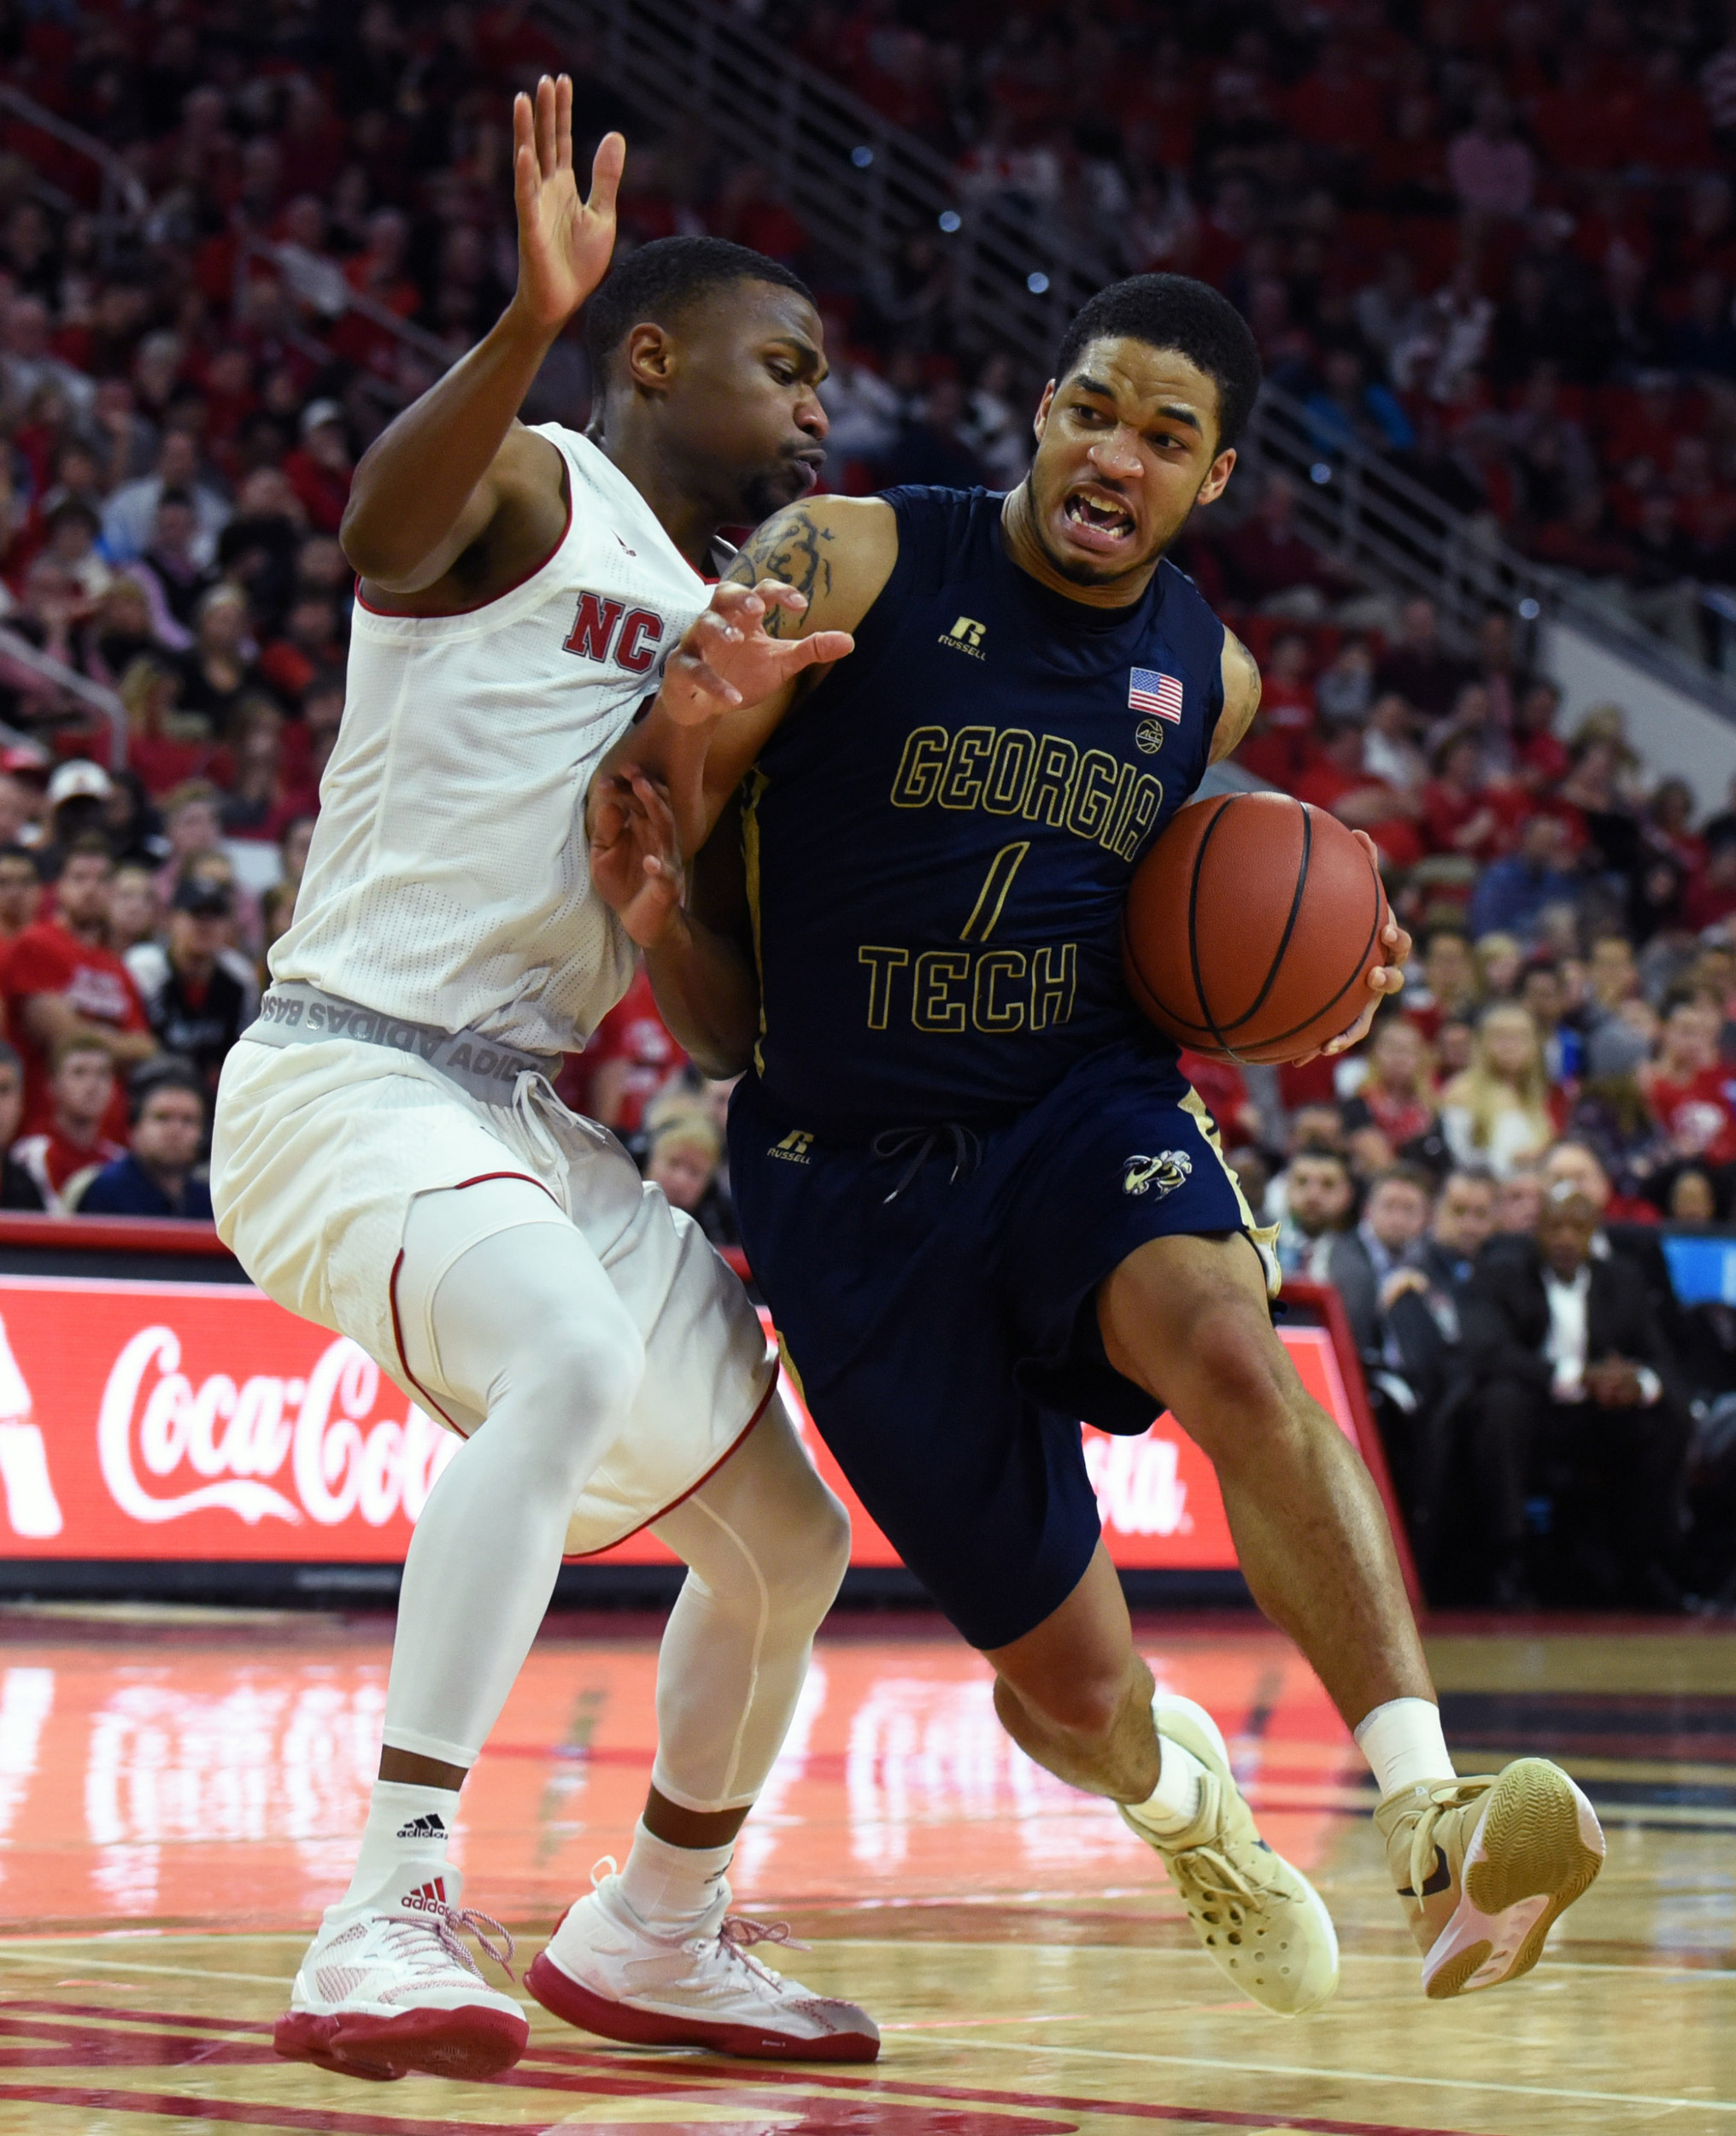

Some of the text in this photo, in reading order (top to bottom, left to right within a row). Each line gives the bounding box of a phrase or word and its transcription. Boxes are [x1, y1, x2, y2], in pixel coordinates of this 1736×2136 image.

[562, 590, 664, 674] NC
[938, 634, 986, 660] RUSSELL
[1138, 729, 1163, 742] ACC
[890, 725, 1164, 861] GEORGIA
[959, 842, 1030, 942] 1
[859, 943, 1076, 1032] TECH
[767, 1147, 811, 1165] RUSSELL
[97, 1324, 468, 1528] Coca-Col
